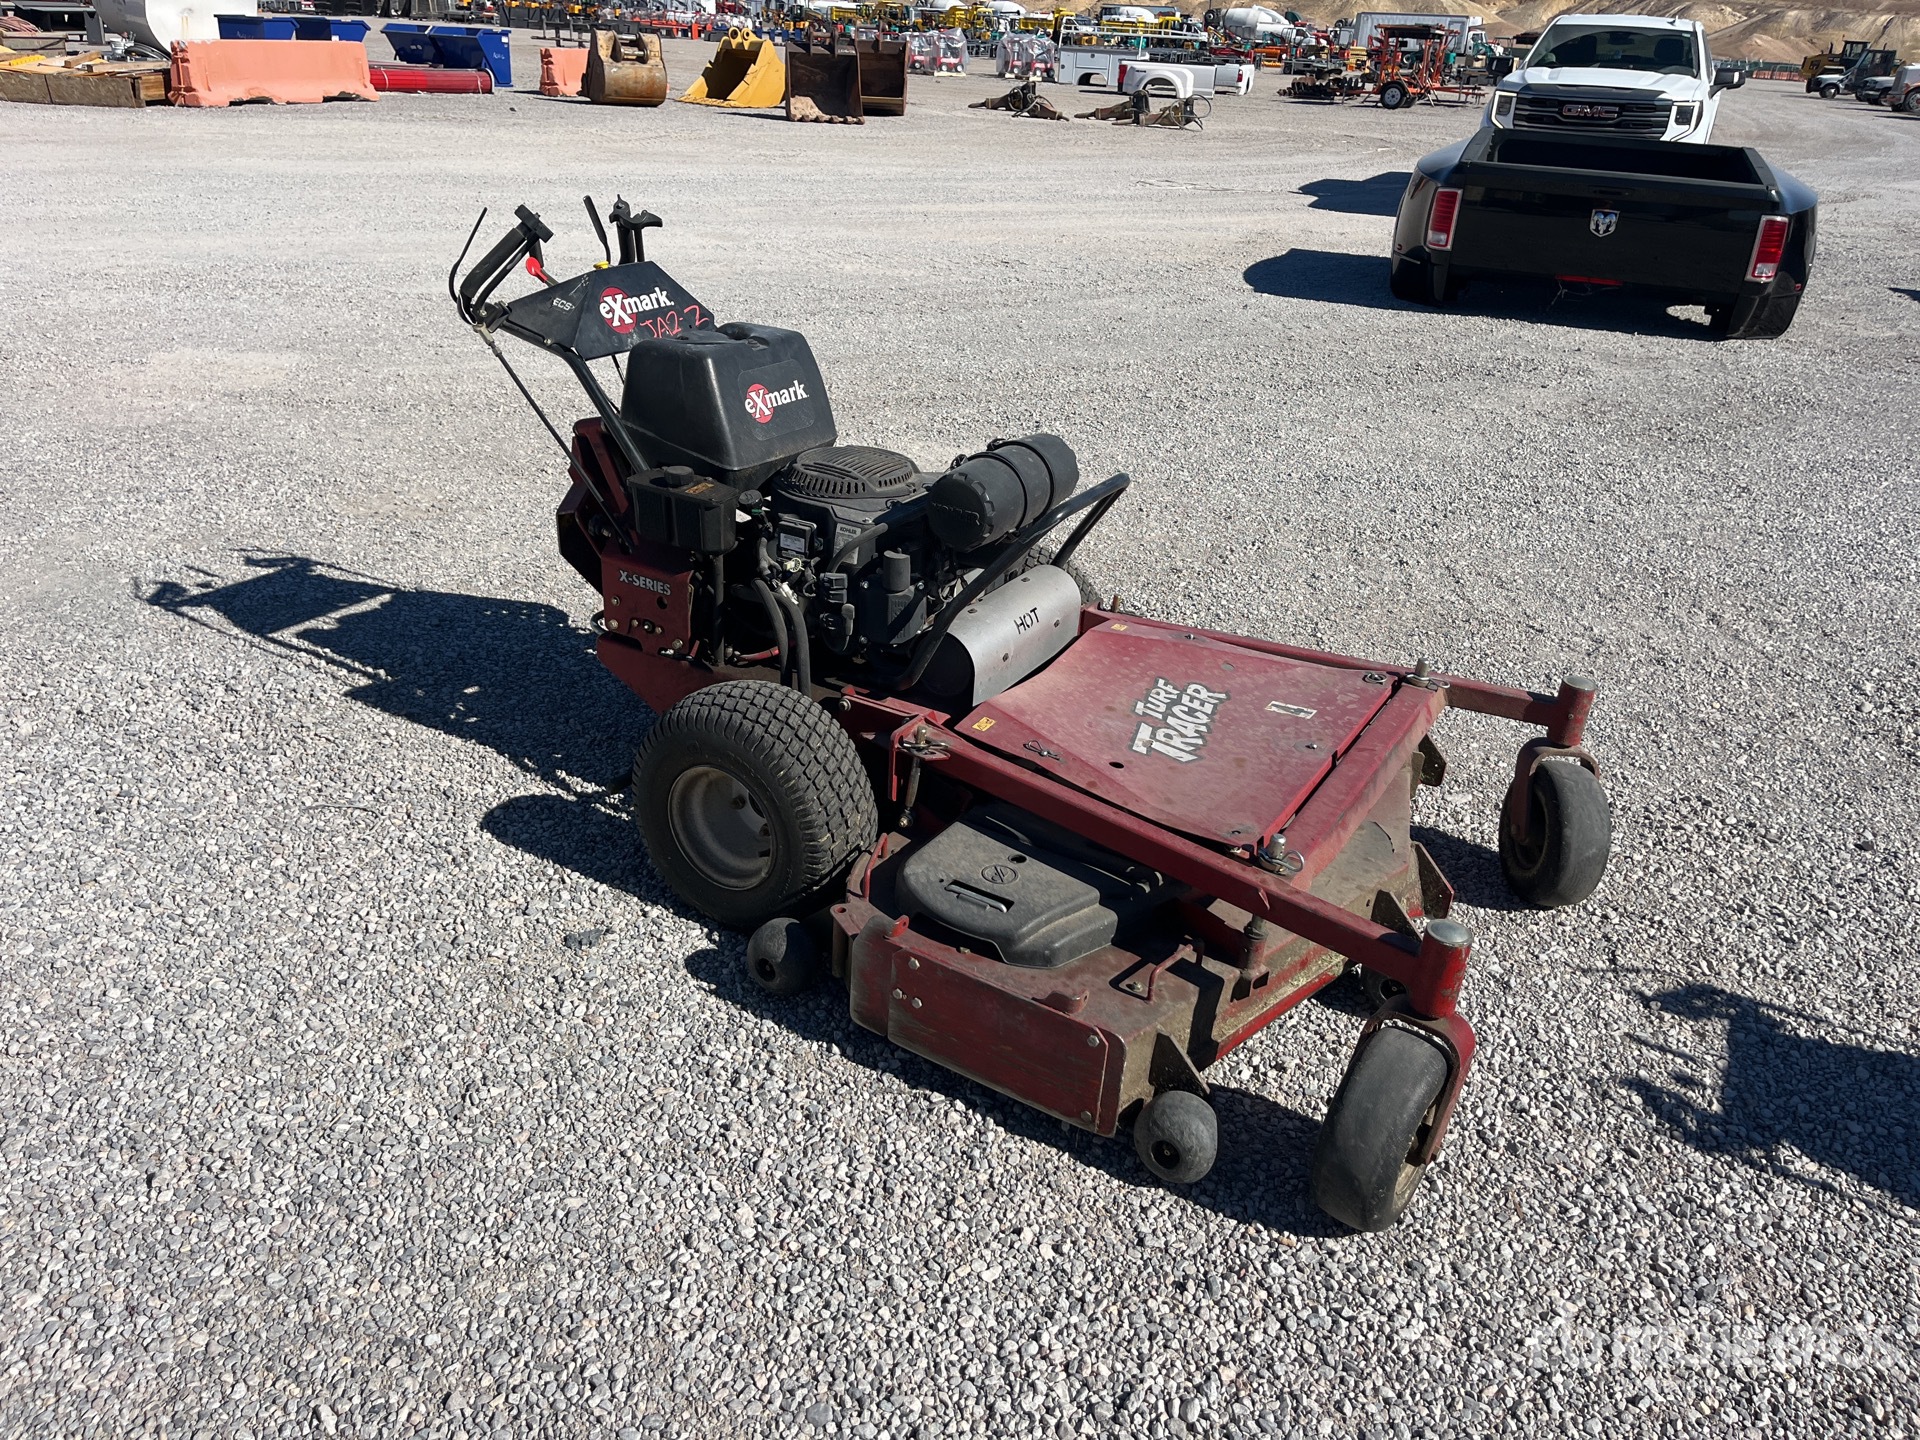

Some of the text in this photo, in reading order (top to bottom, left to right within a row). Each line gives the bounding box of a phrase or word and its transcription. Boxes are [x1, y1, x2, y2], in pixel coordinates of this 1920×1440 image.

[1562, 104, 1620, 119] GMC
[618, 569, 672, 596] X-SERIES
[1013, 606, 1040, 635] HOT
[1134, 677, 1181, 720] TURF
[1131, 683, 1228, 763] TRACER
